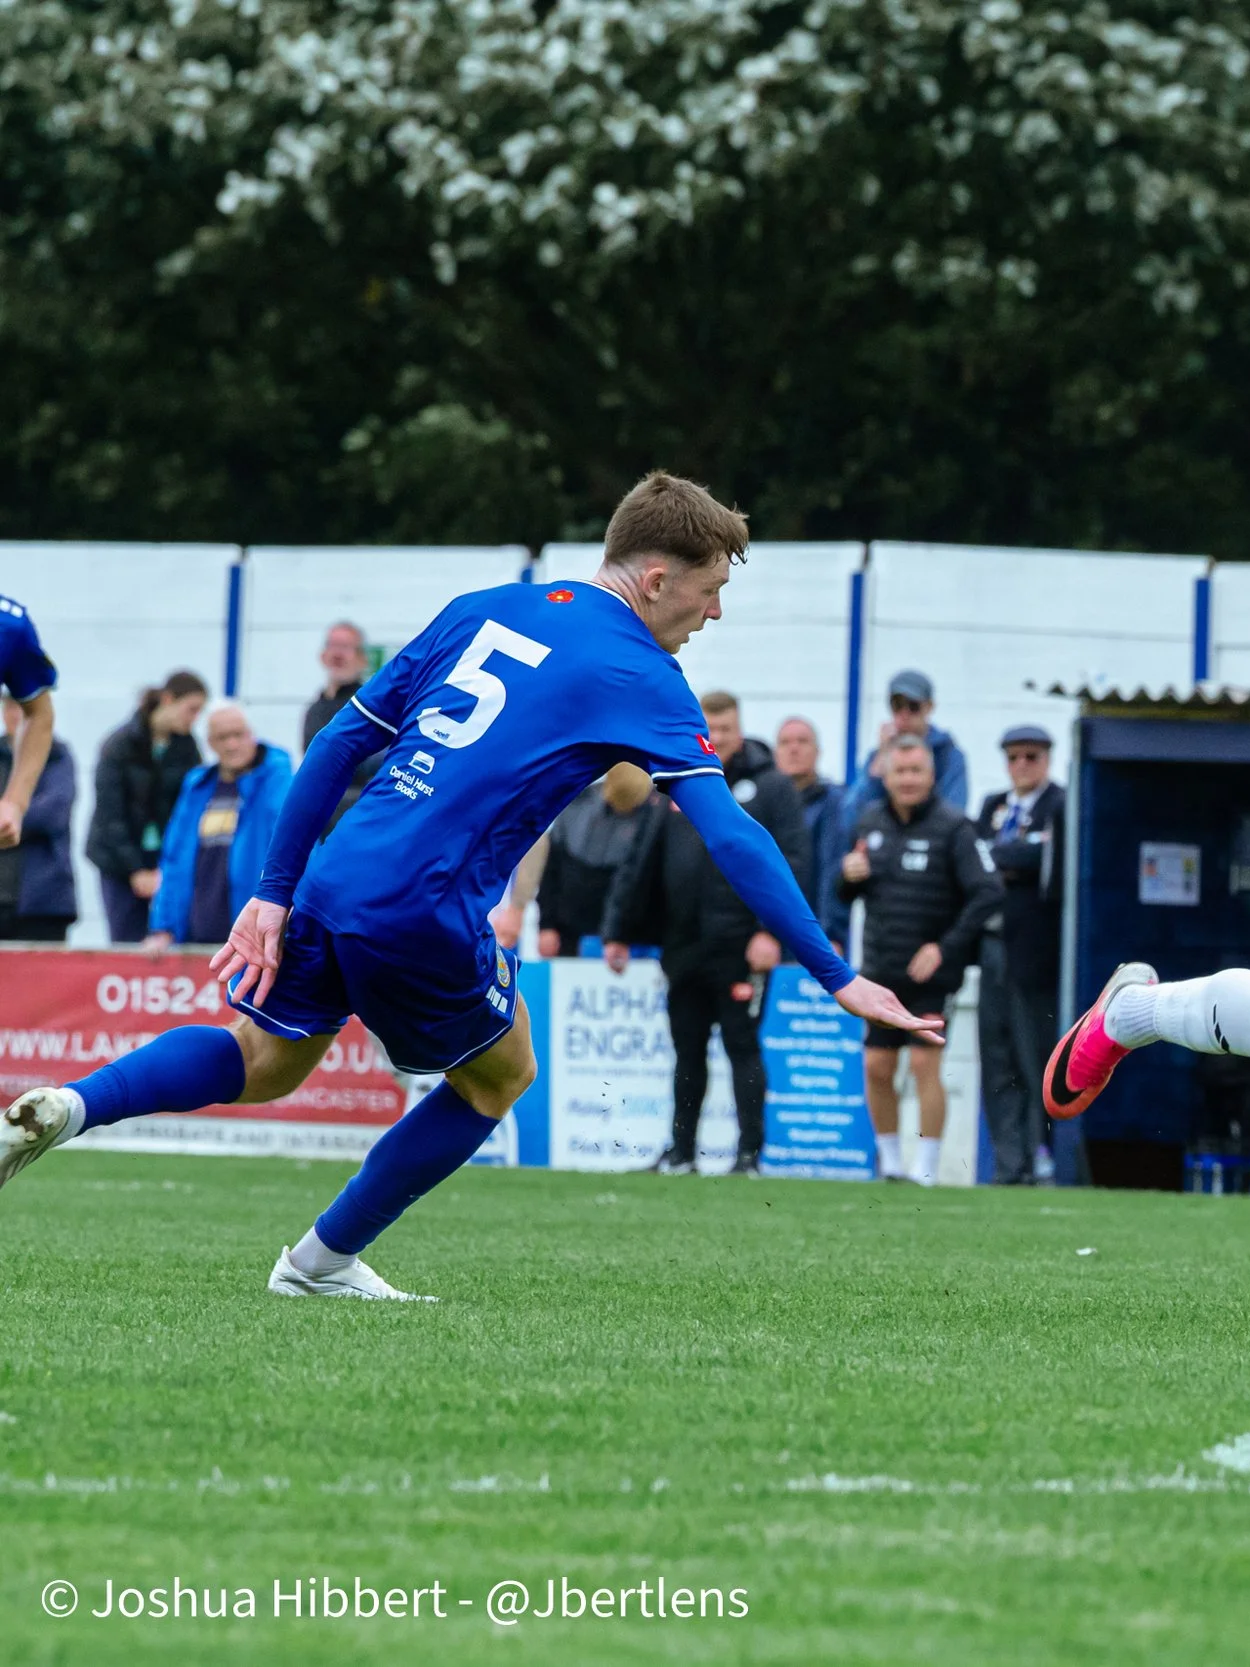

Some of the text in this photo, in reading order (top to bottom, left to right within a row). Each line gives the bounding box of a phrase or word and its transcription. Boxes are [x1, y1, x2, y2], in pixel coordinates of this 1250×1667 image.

[416, 619, 553, 749] 5
[389, 765, 435, 796] Daniel Hurst
[394, 780, 418, 800] Books
[96, 974, 222, 1015] 01524
